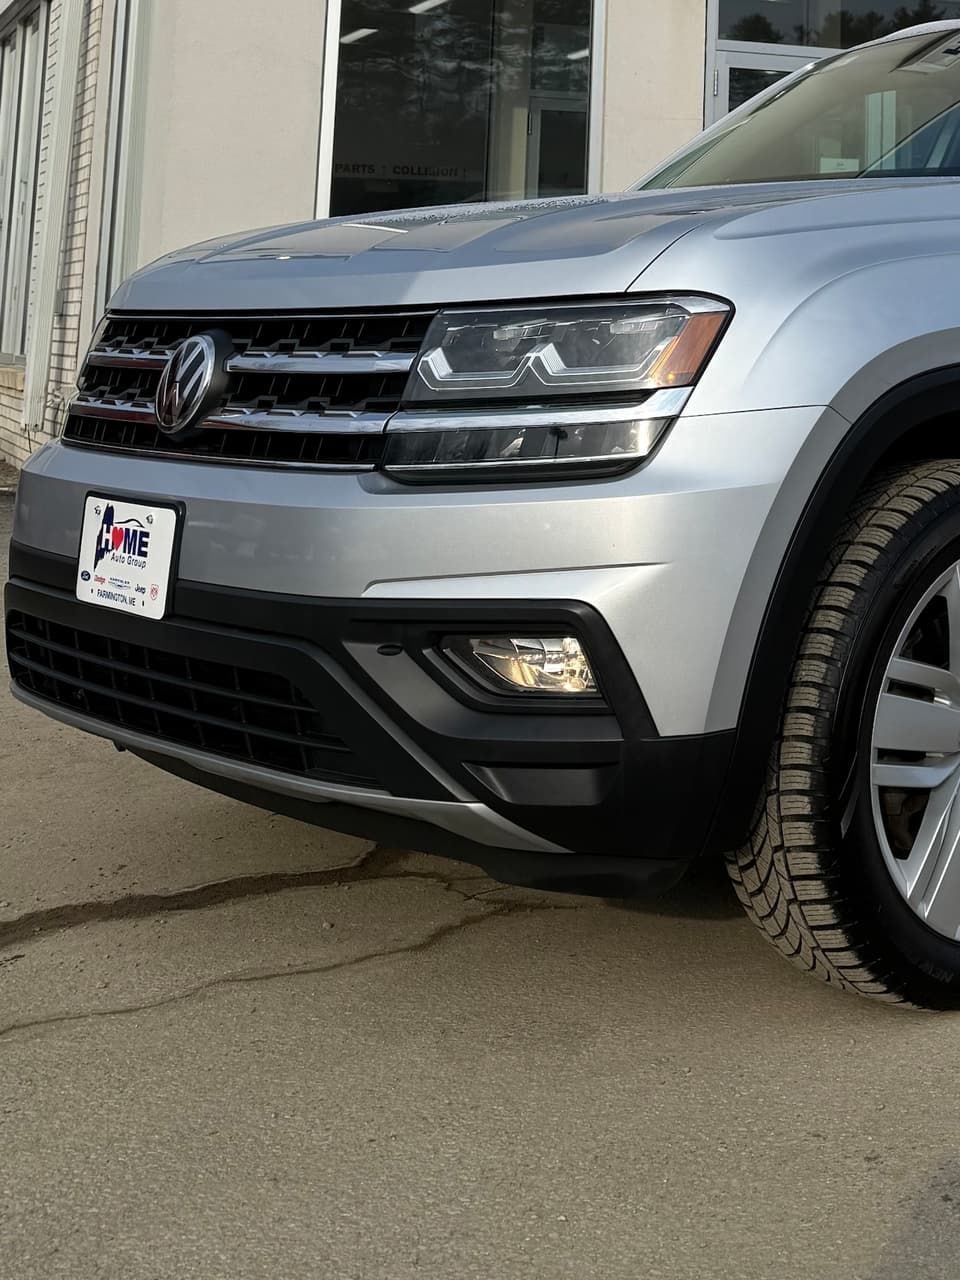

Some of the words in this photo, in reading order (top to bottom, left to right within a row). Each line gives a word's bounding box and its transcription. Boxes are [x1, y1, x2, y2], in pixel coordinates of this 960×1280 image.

[335, 163, 376, 176] PARTS
[110, 552, 126, 564] Auto
[126, 555, 147, 569] Group
